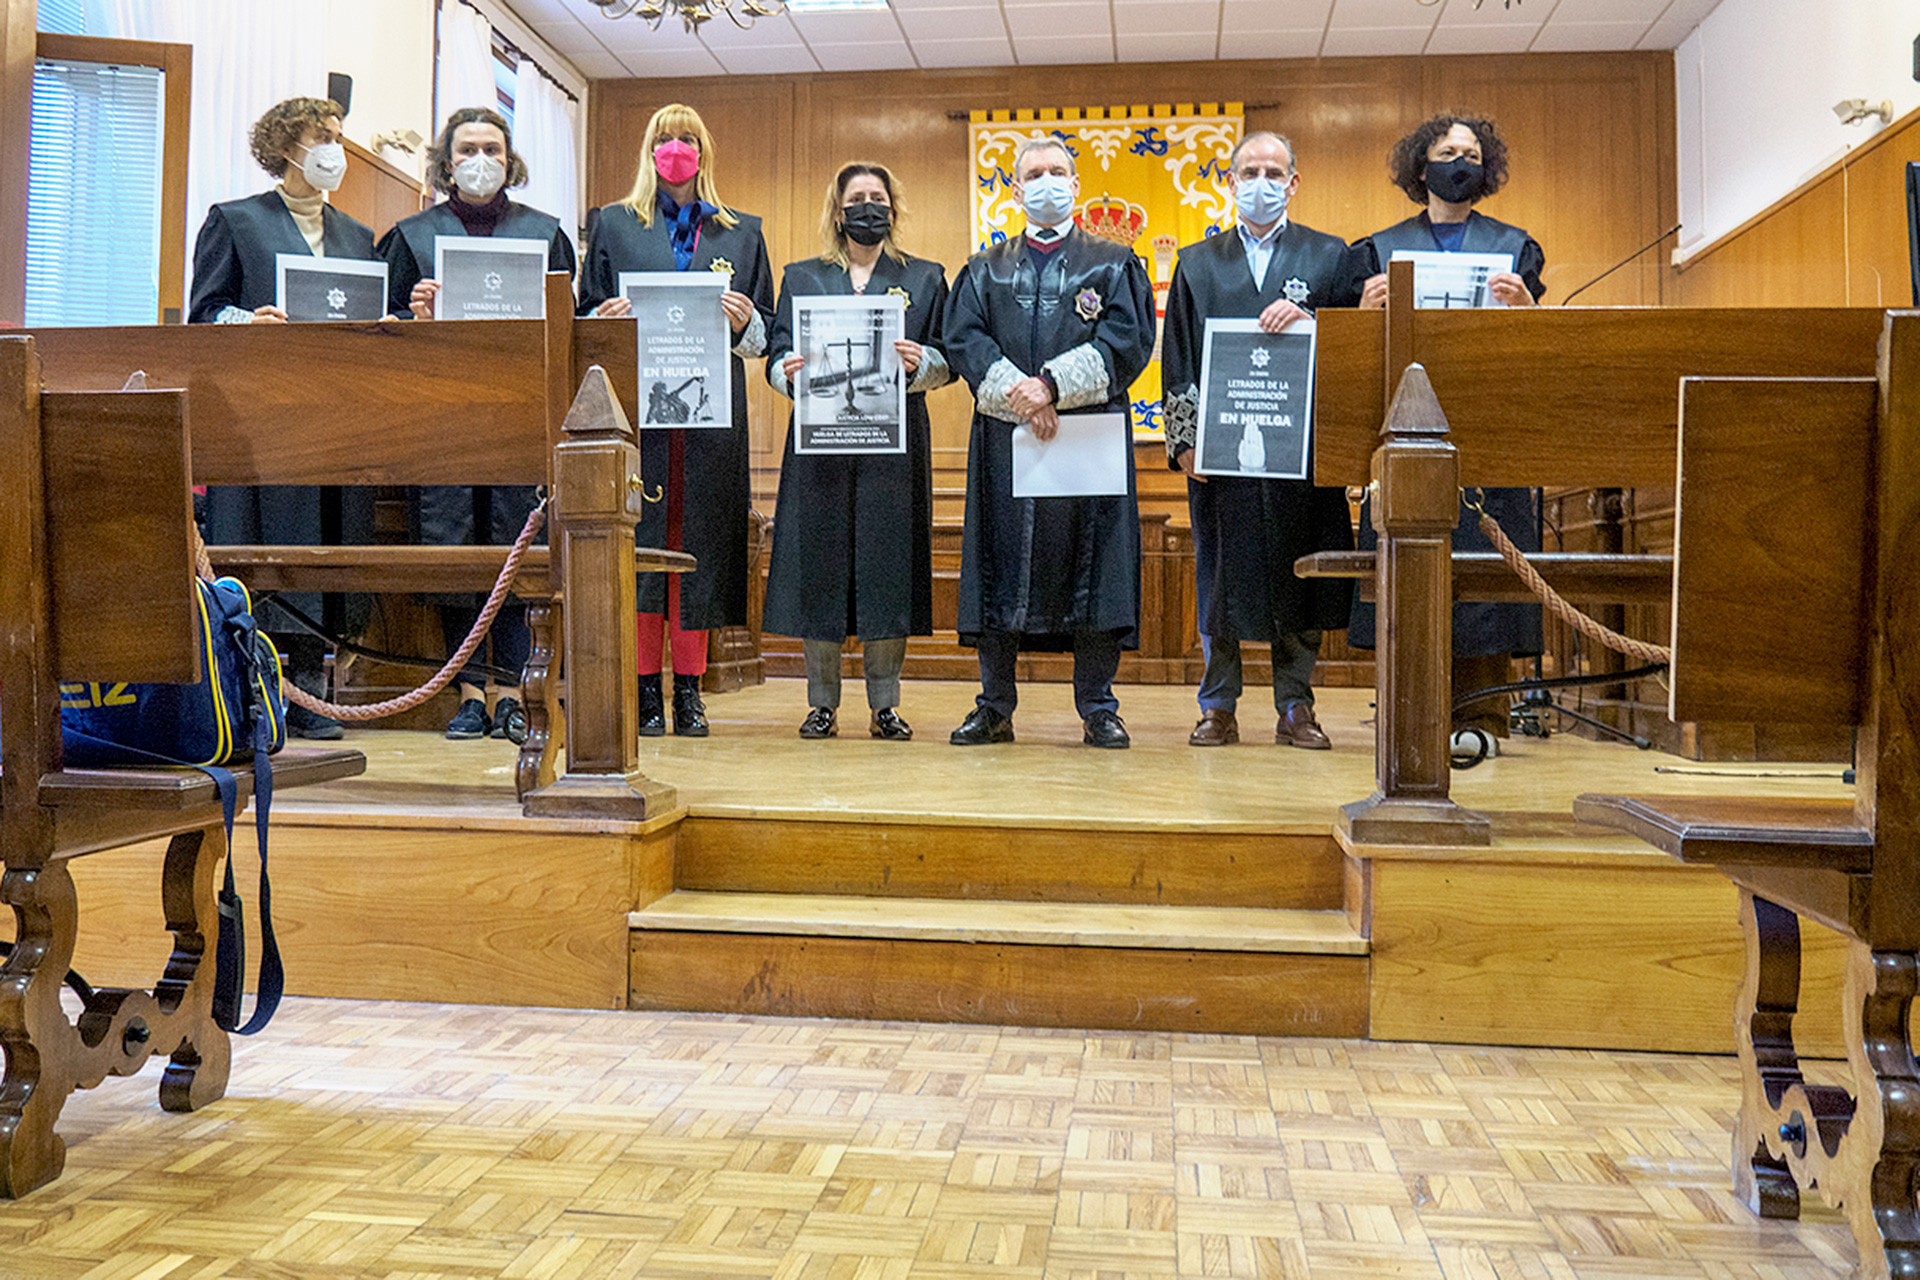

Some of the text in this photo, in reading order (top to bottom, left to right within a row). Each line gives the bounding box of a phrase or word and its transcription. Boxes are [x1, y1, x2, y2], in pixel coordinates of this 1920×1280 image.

[463, 302, 522, 312] LETRADOS DE LA
[647, 336, 705, 344] LETRADOS DE LA
[655, 356, 665, 364] DE
[643, 367, 710, 378] EN HUELGA
[1227, 379, 1289, 390] LETRADOS DE LA
[1227, 390, 1288, 400] ADMINISTRACIÓN
[1234, 401, 1279, 411] DE JUSTICIA
[1220, 412, 1292, 427] EN HUELGA
